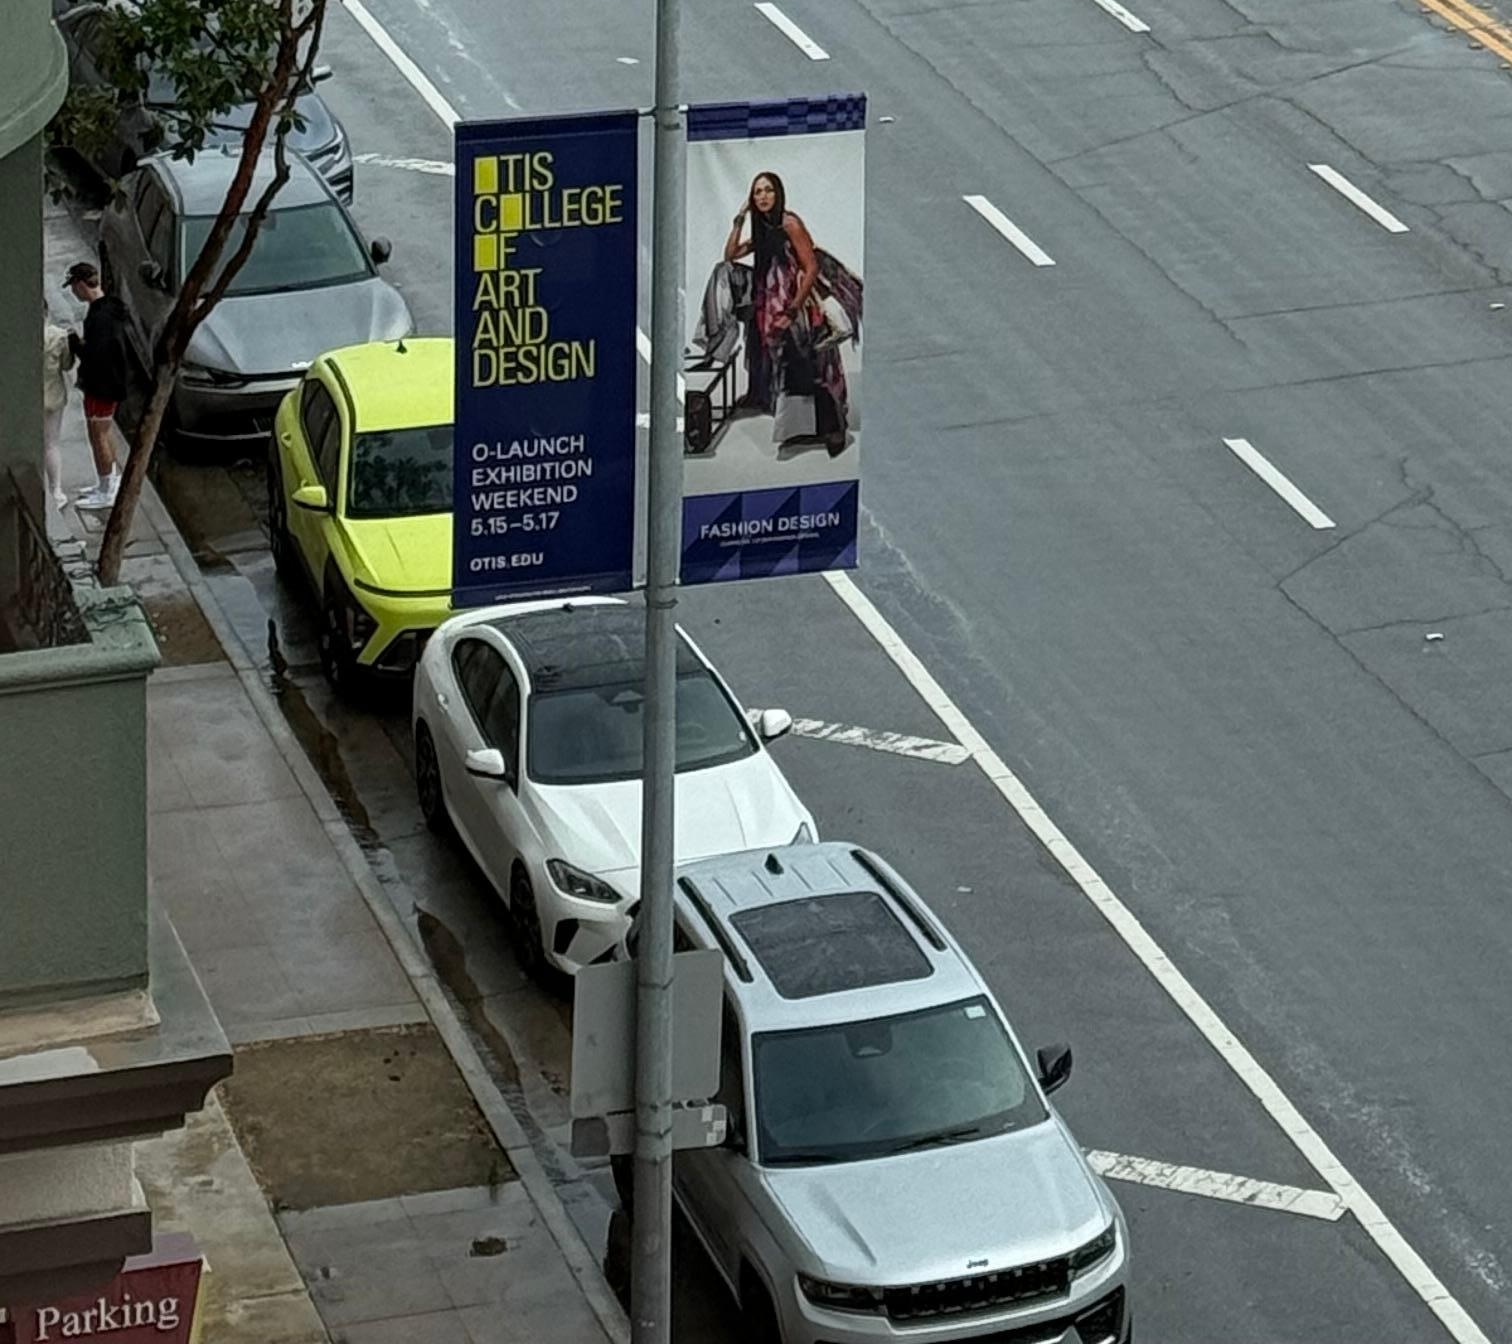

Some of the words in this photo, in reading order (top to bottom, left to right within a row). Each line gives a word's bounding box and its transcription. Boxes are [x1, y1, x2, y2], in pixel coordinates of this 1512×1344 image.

[472, 268, 543, 310] ART
[472, 307, 549, 348] AND
[472, 339, 596, 388] DESIGN
[472, 434, 585, 462] O-LAUNCH
[472, 458, 593, 487] EXHIBITION
[471, 485, 578, 511] WEEKEND
[700, 518, 773, 540] FASHION
[778, 512, 840, 532] DESIGN
[470, 552, 544, 572] OTIS.EDU
[34, 1293, 180, 1342] Parking
